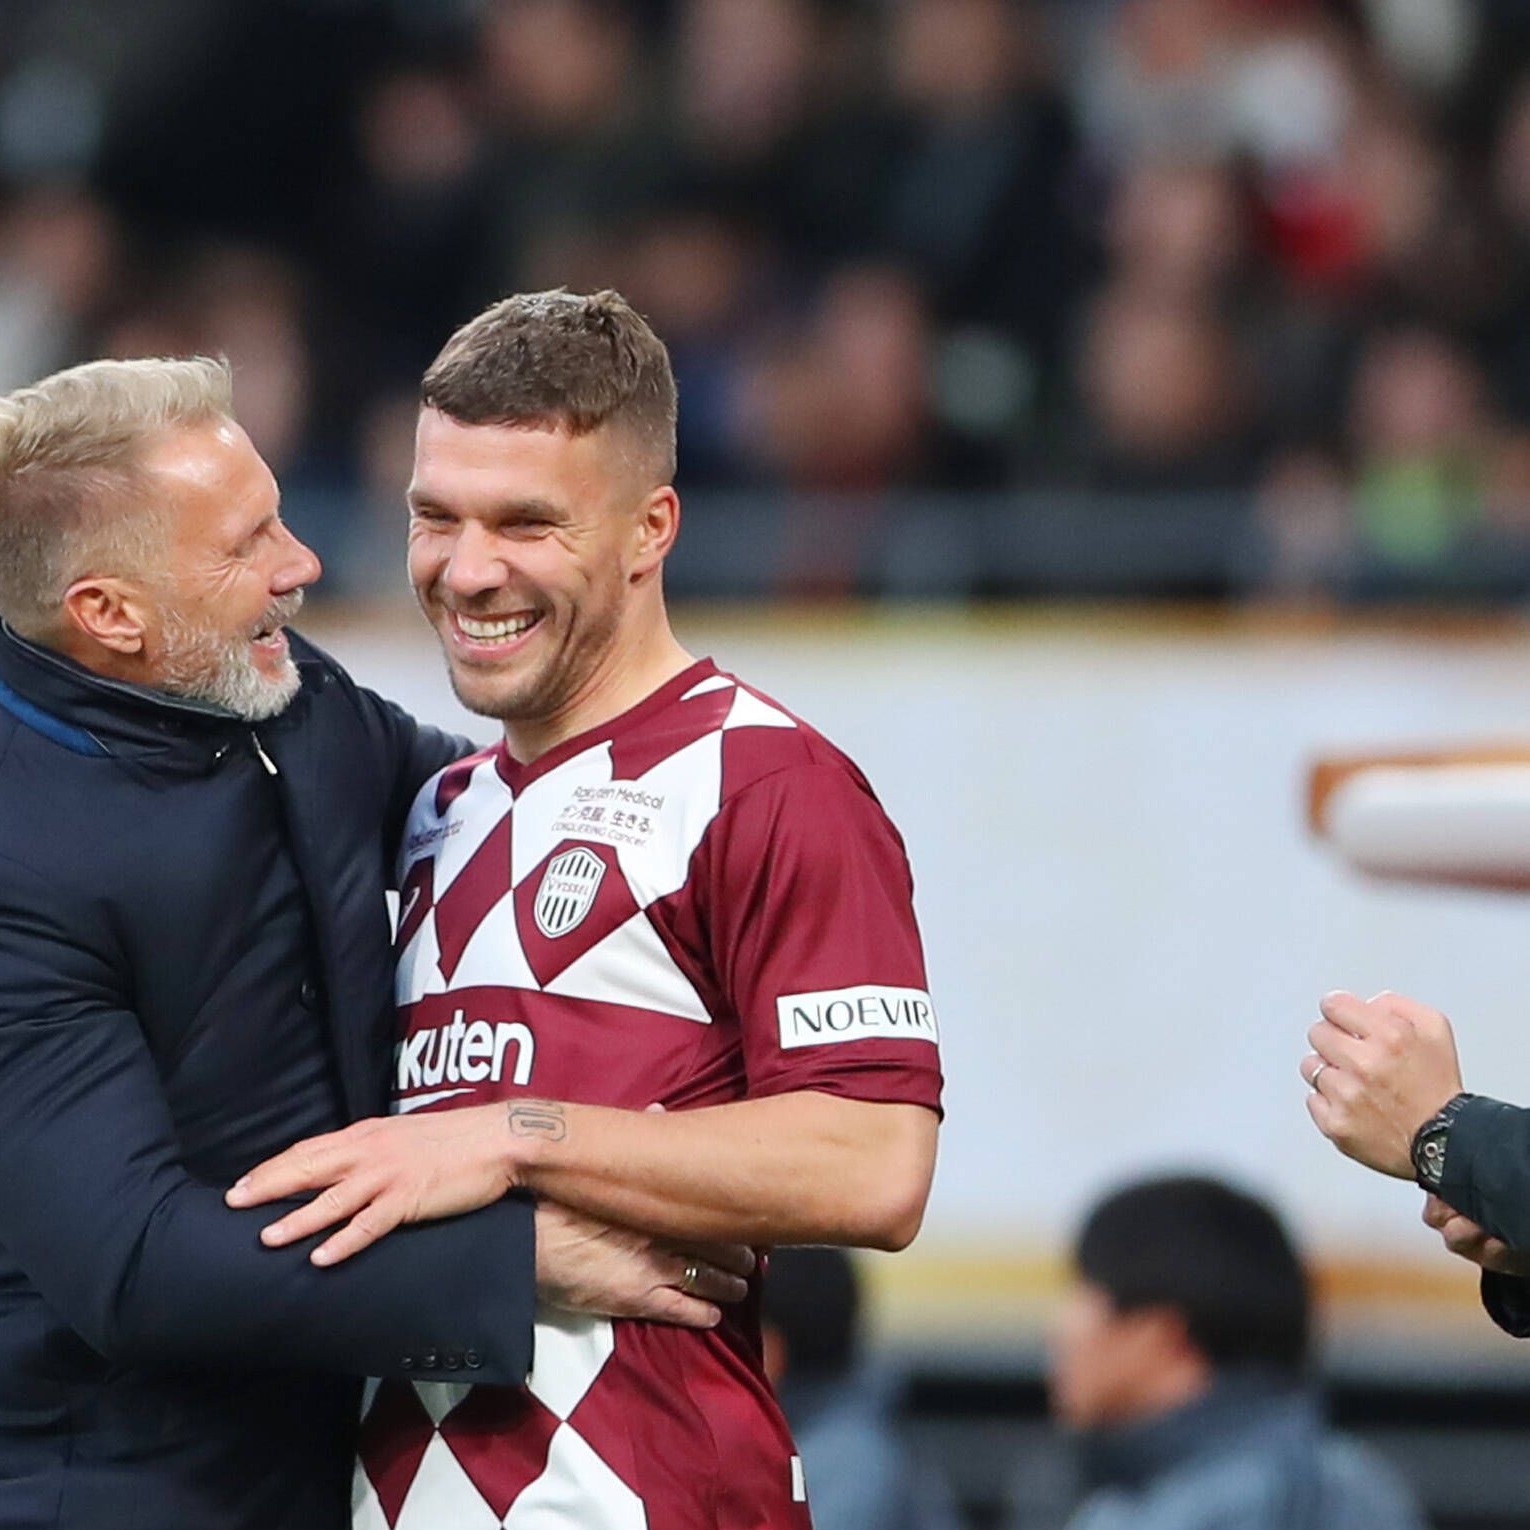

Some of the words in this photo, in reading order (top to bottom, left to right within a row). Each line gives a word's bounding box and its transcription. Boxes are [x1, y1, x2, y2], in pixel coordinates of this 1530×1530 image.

[615, 787, 665, 810] Medical
[792, 996, 933, 1036] NOEVIR
[394, 1009, 535, 1090] kuten
